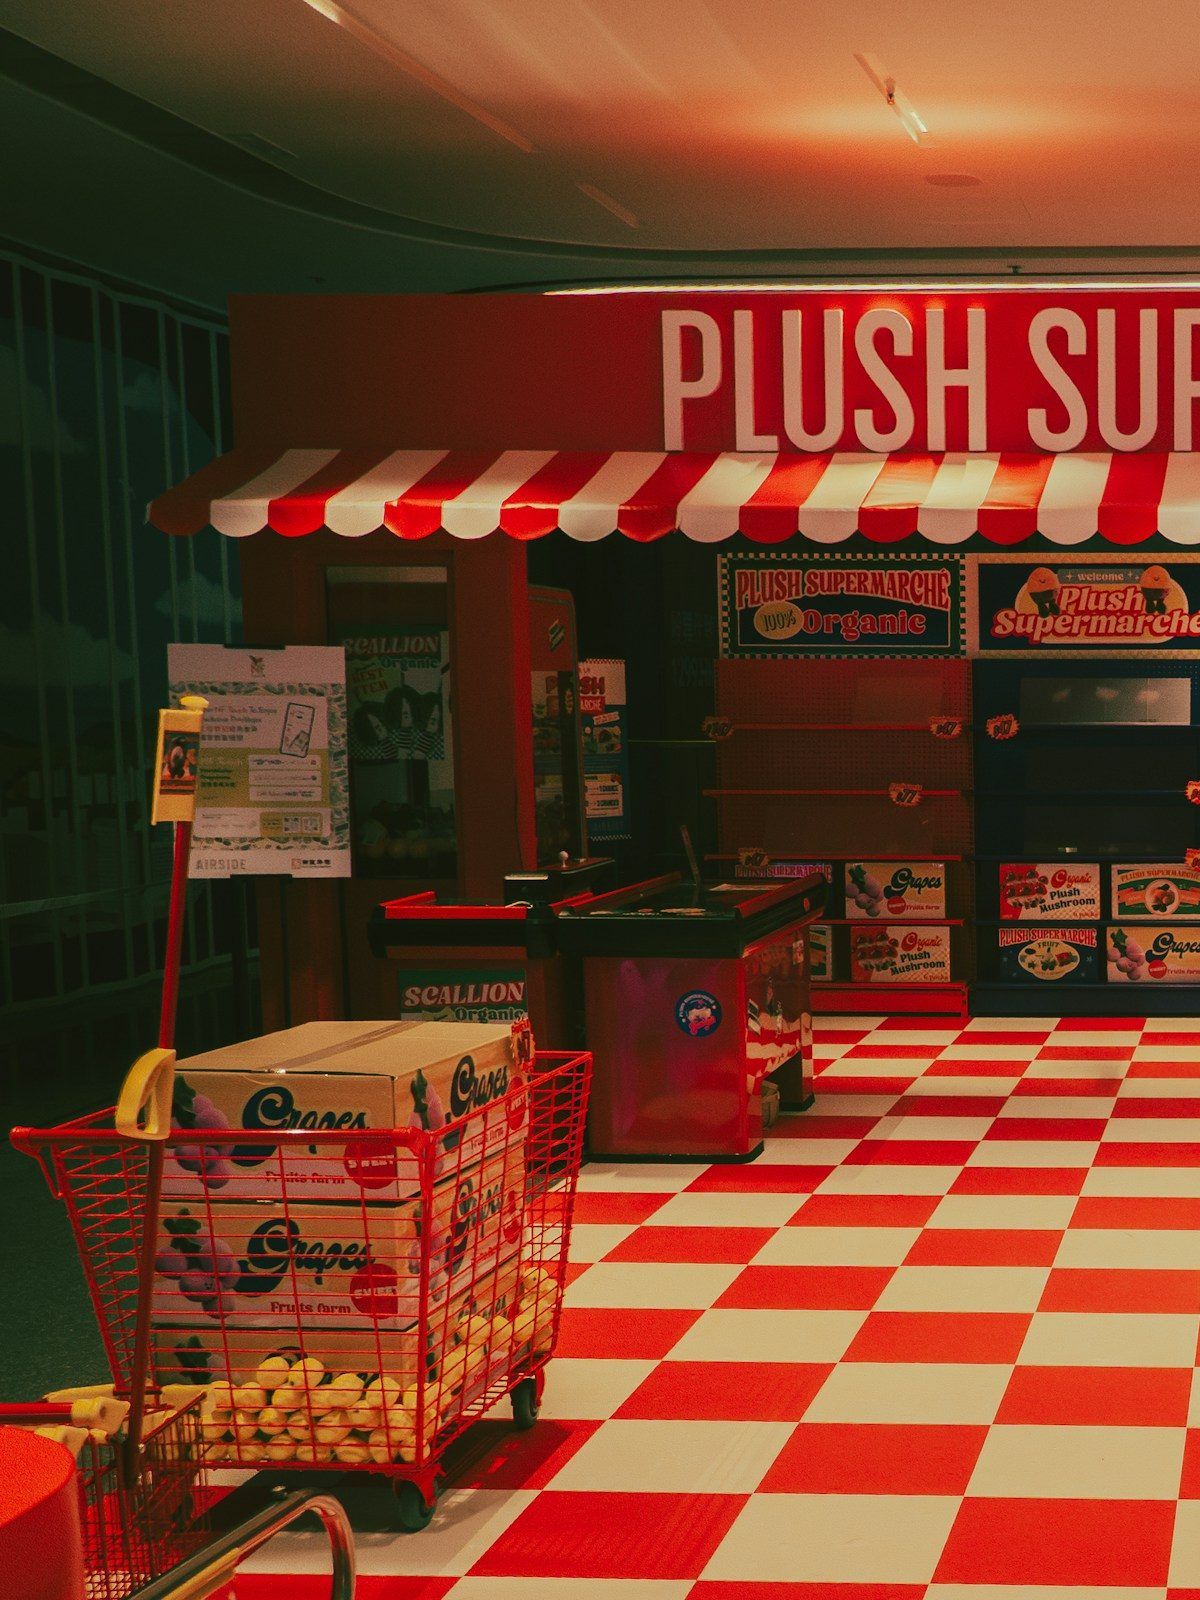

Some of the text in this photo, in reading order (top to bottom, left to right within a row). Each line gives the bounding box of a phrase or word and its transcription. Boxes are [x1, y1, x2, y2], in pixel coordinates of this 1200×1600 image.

[661, 307, 988, 453] PLUSH
[1078, 572, 1125, 582] welcome
[736, 570, 802, 610] PLUSH
[1060, 585, 1145, 613] Plush
[762, 608, 927, 642] 100% Organic
[196, 858, 247, 870] AIRSIDE
[883, 867, 942, 899] Grapes
[1050, 869, 1092, 889] Organic
[1049, 889, 1081, 901] Plush
[1039, 897, 1096, 914] Mushroom
[901, 932, 942, 952] Organic
[998, 928, 1031, 947] PLUSH
[900, 951, 930, 963] Plush
[890, 960, 945, 975] Mushroom
[403, 982, 525, 1008] SCALLION
[454, 1006, 527, 1024] Organic
[234, 1218, 377, 1297] Grapes
[271, 1302, 351, 1314] Fruits farm
